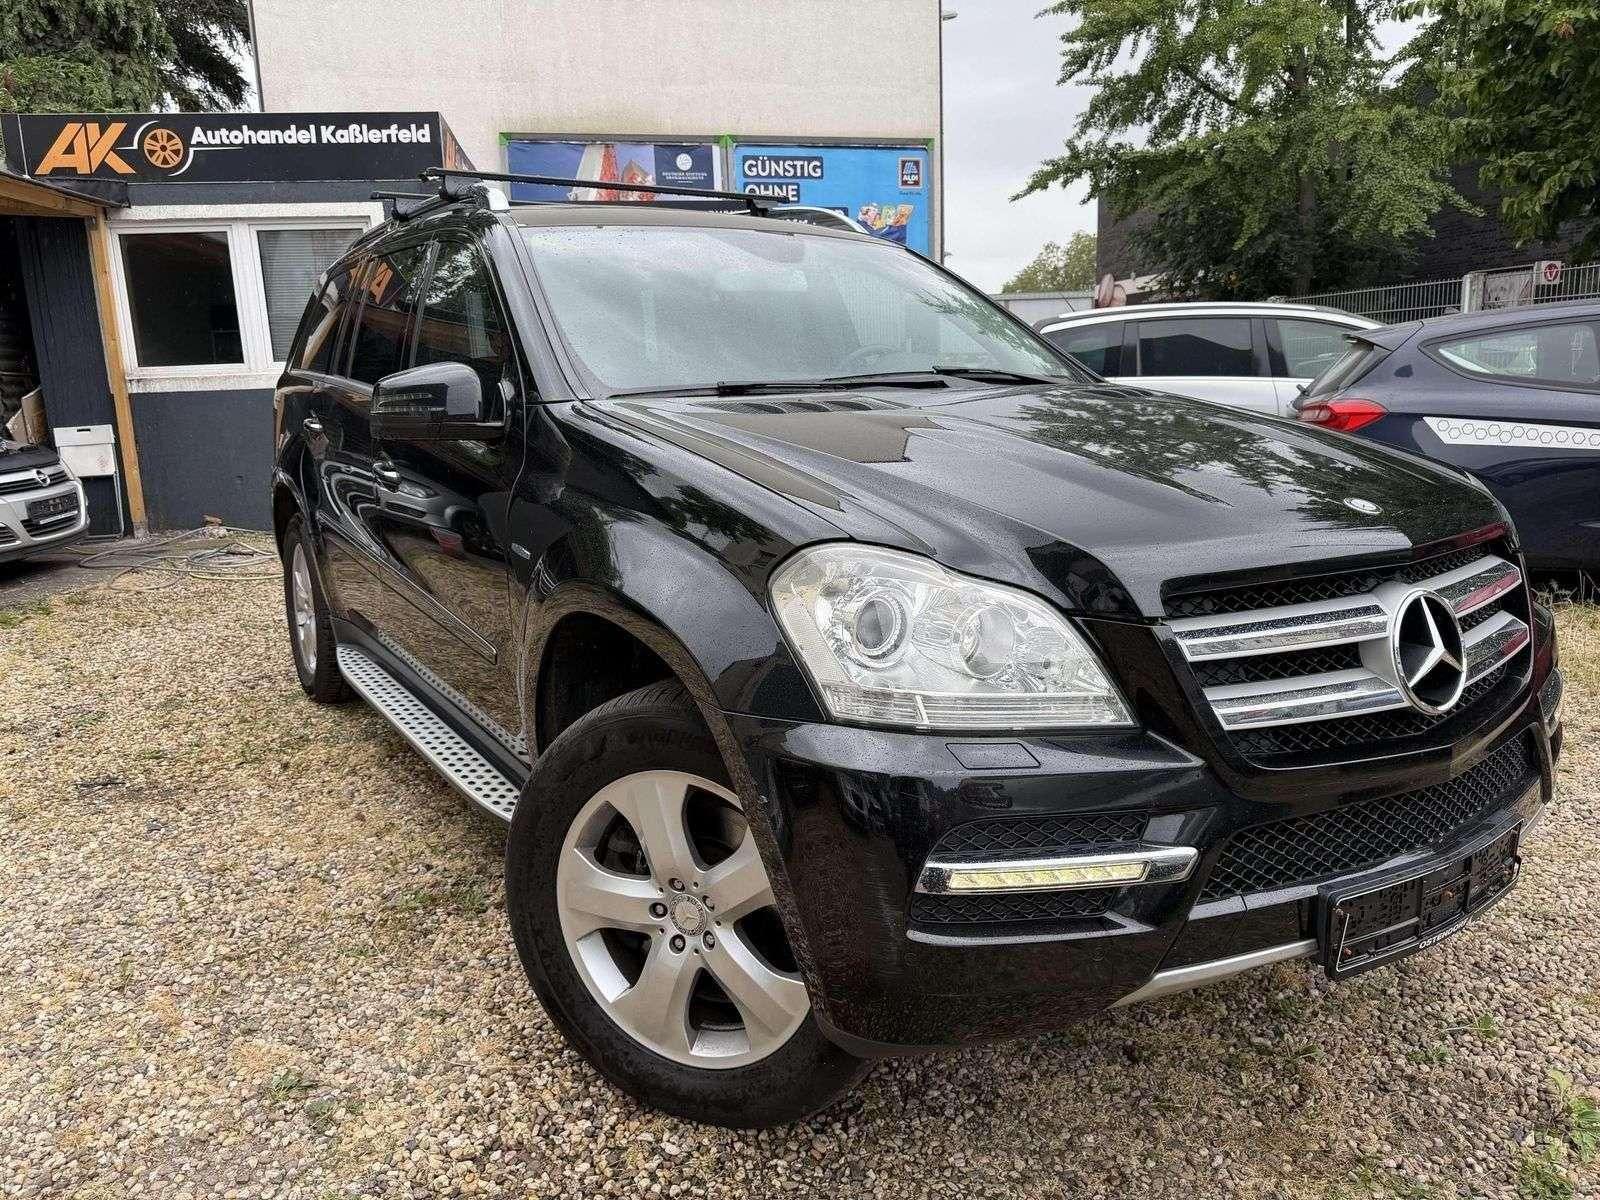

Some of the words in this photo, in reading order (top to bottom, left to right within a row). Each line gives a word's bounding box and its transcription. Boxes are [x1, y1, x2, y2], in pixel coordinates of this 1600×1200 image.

[190, 125, 316, 145] Autohandel
[320, 124, 430, 143] Kaßlerfeld
[34, 122, 136, 175] AK
[743, 156, 822, 177] GÜNSTIG
